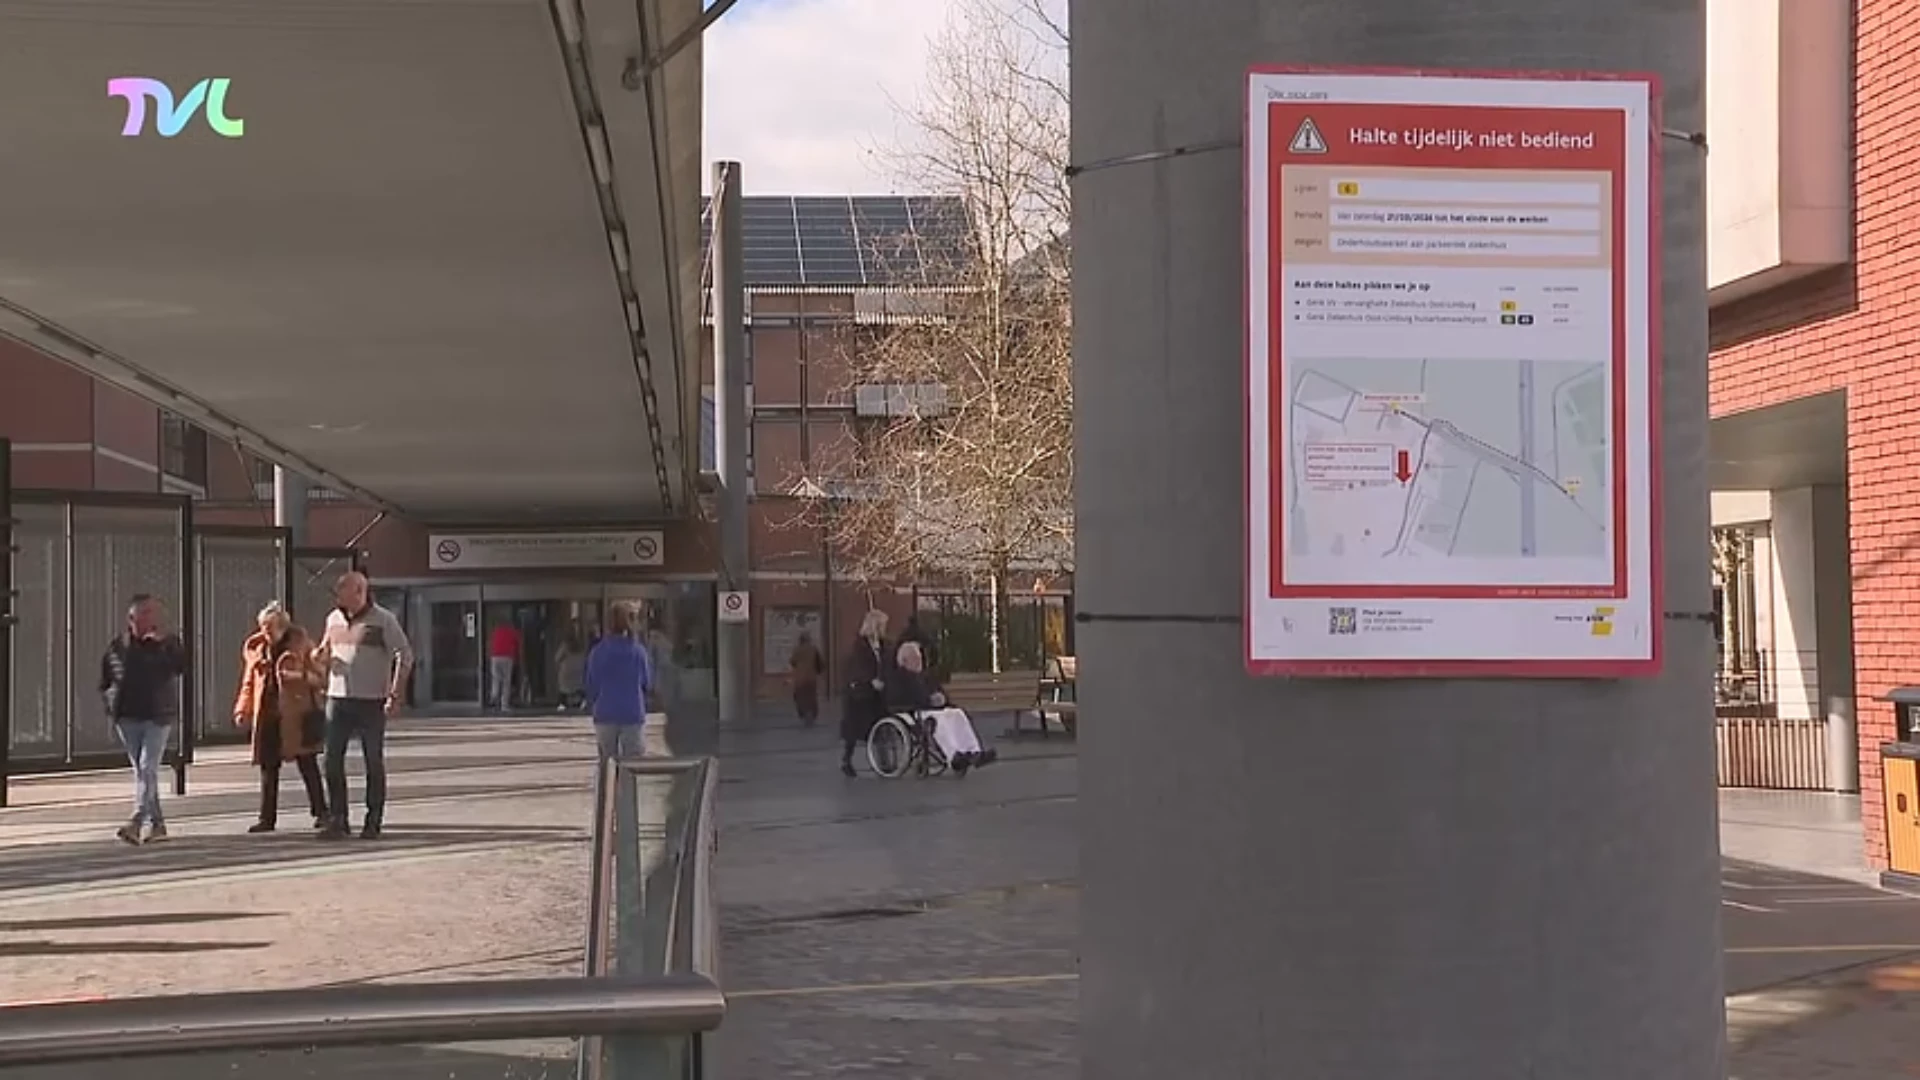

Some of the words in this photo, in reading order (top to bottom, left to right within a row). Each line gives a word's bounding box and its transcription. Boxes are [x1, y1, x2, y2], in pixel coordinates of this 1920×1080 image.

[1350, 127, 1397, 145] Halte
[1404, 127, 1473, 150] tijdelijk
[1479, 130, 1516, 147] niet
[1521, 130, 1594, 148] bediend
[1335, 280, 1361, 289] haltes
